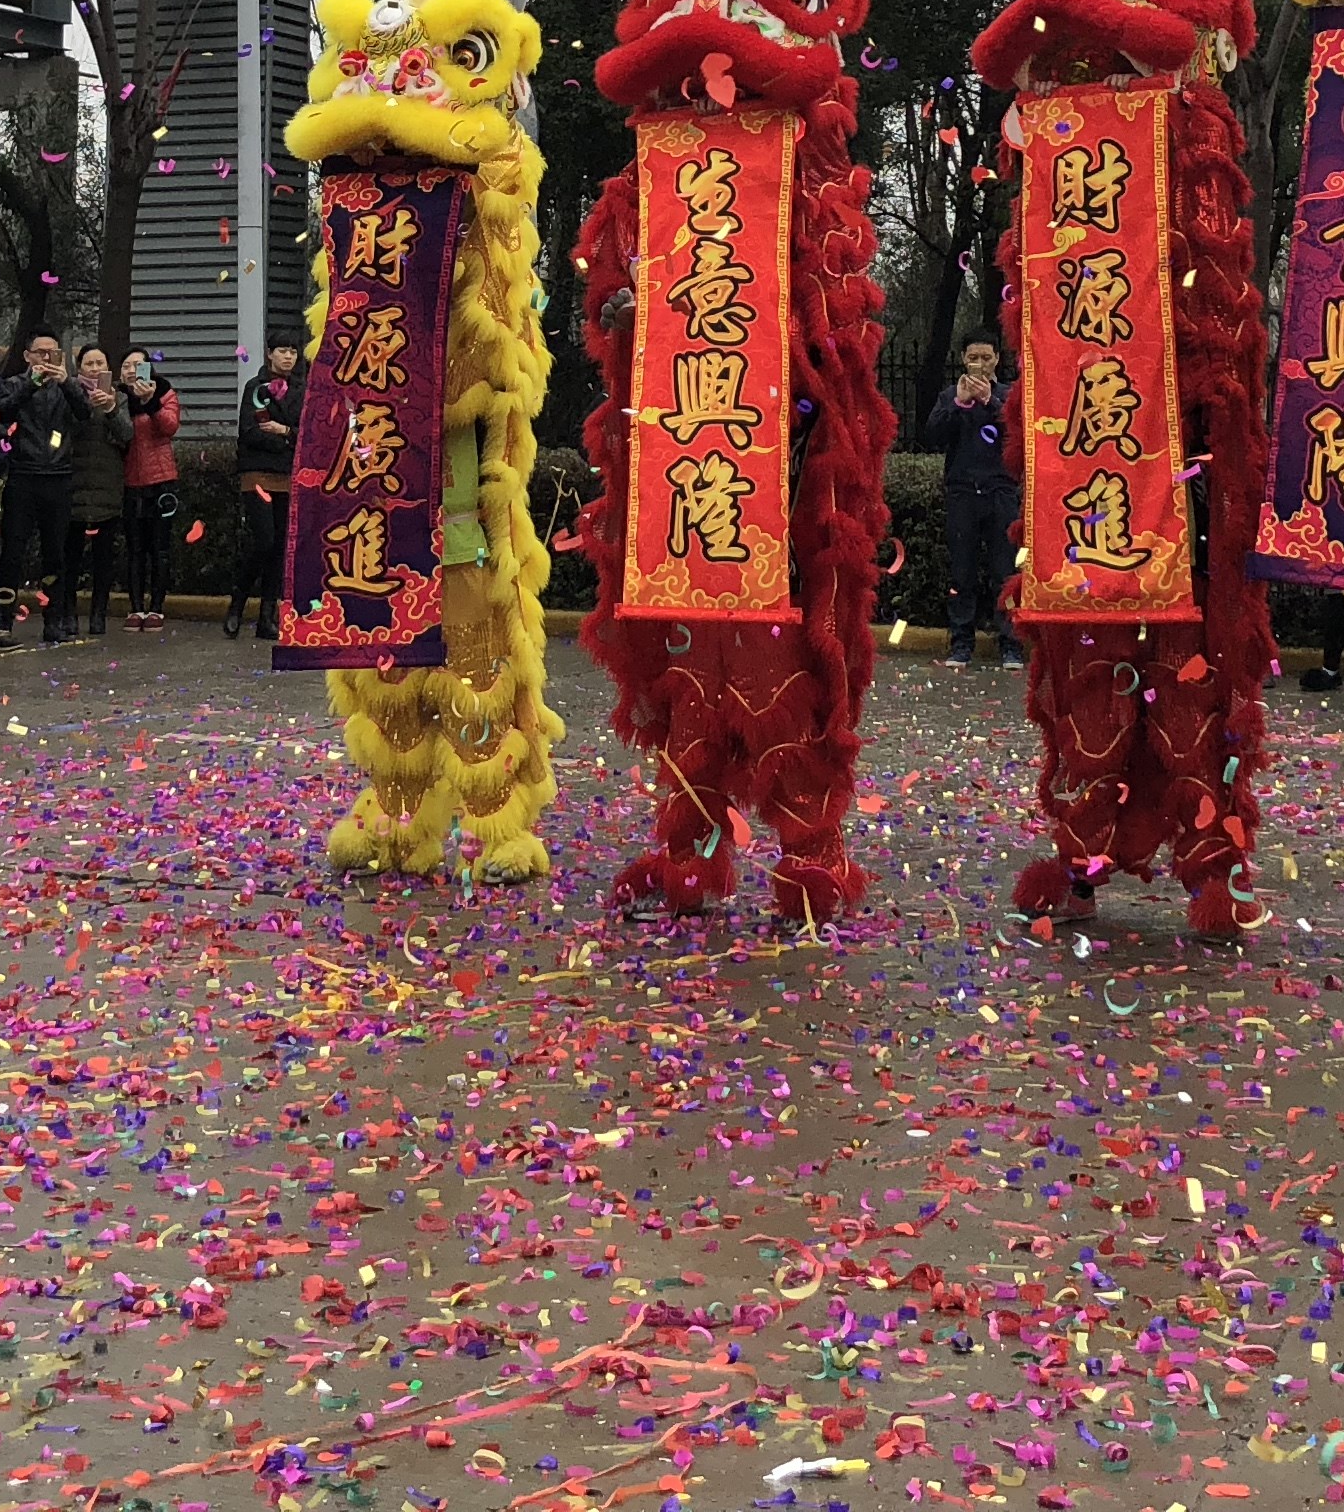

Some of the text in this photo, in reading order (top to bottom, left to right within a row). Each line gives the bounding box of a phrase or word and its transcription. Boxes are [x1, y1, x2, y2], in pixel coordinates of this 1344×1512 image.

[325, 208, 420, 597] 財源廣進
[658, 149, 762, 563] 生意興隆
[1052, 141, 1152, 571] 財源廣進
